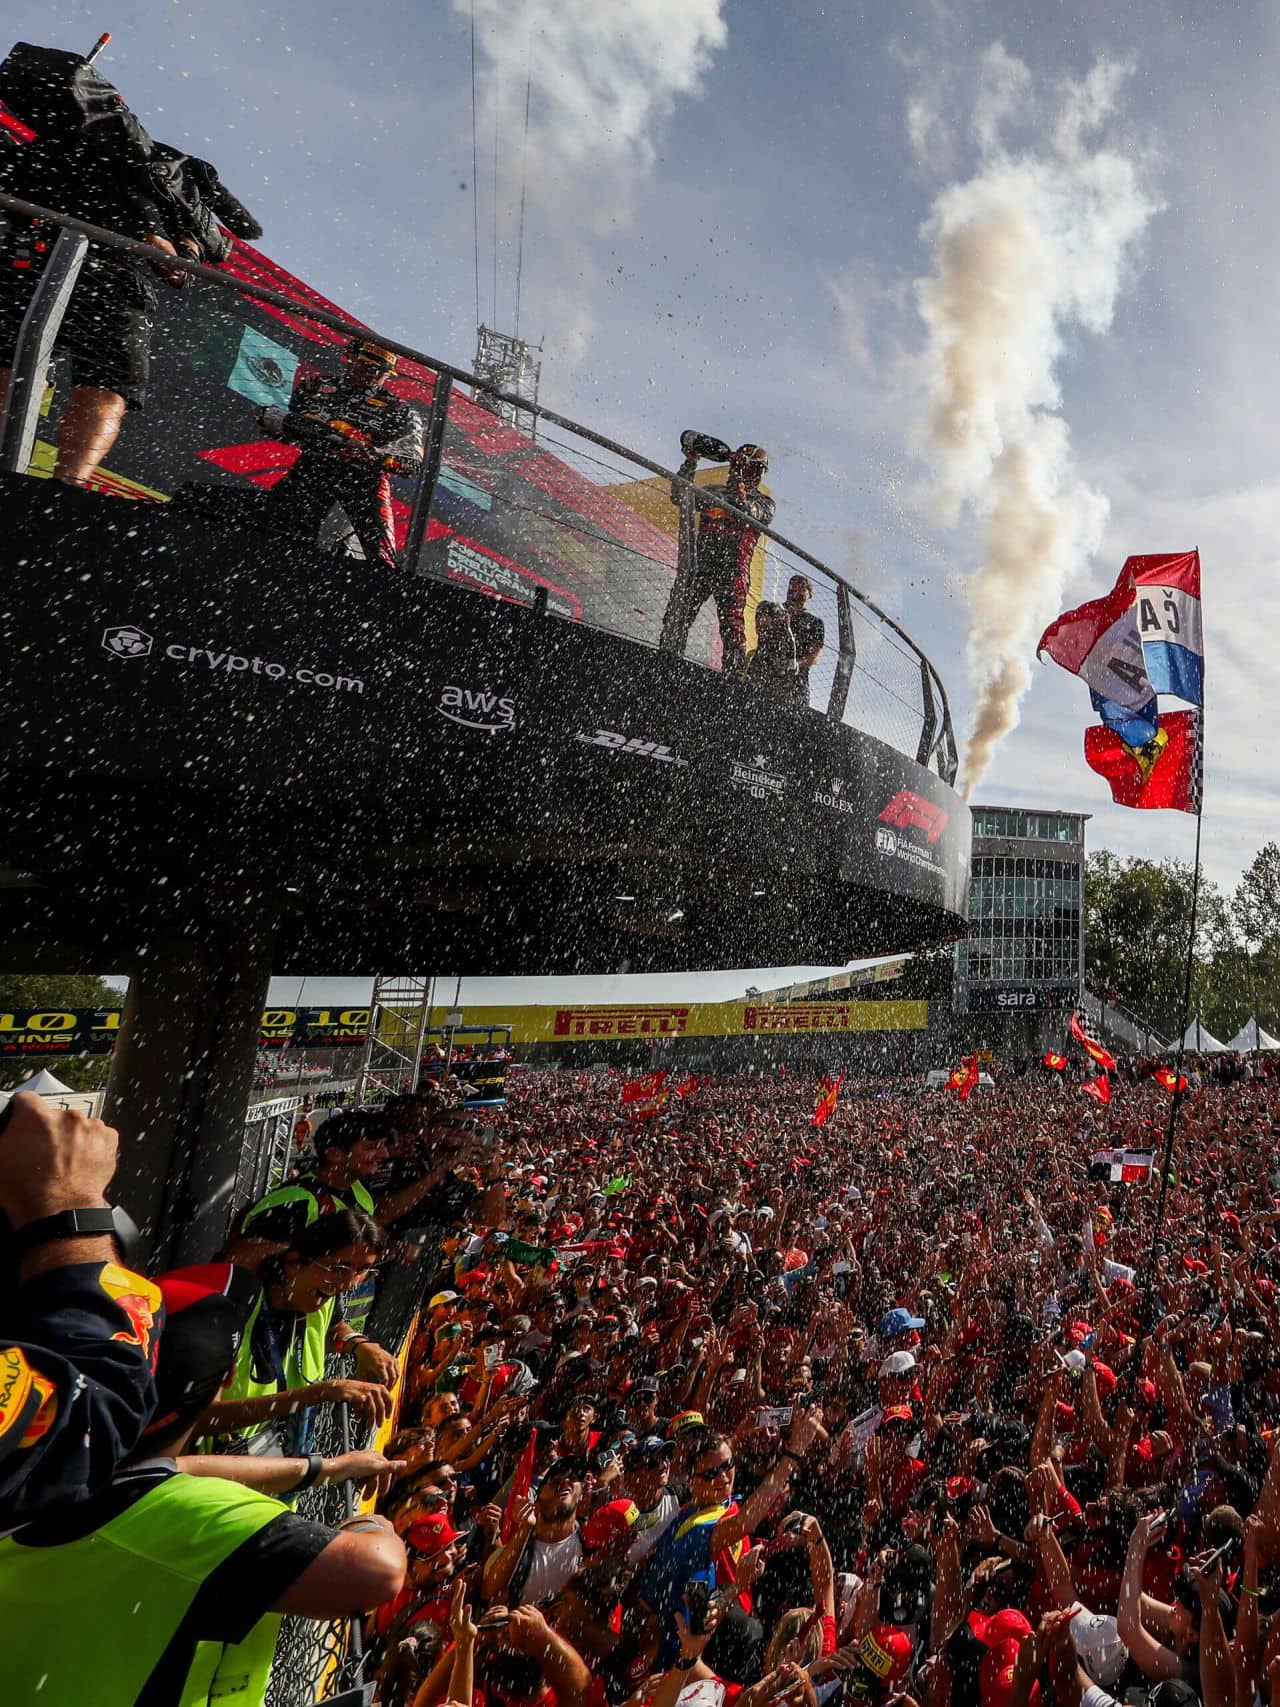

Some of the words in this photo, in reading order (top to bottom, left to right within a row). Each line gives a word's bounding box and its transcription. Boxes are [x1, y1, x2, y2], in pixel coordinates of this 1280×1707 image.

[166, 643, 365, 694] crypto.com
[441, 686, 515, 717] aws
[593, 729, 676, 763] DHL
[733, 766, 783, 789] Heineken
[814, 792, 853, 814] ROLEX
[997, 992, 1036, 1006] sara
[554, 1008, 688, 1035] PIRELLI
[744, 1006, 850, 1030] PIRELLI
[0, 1351, 20, 1409] RAUC
